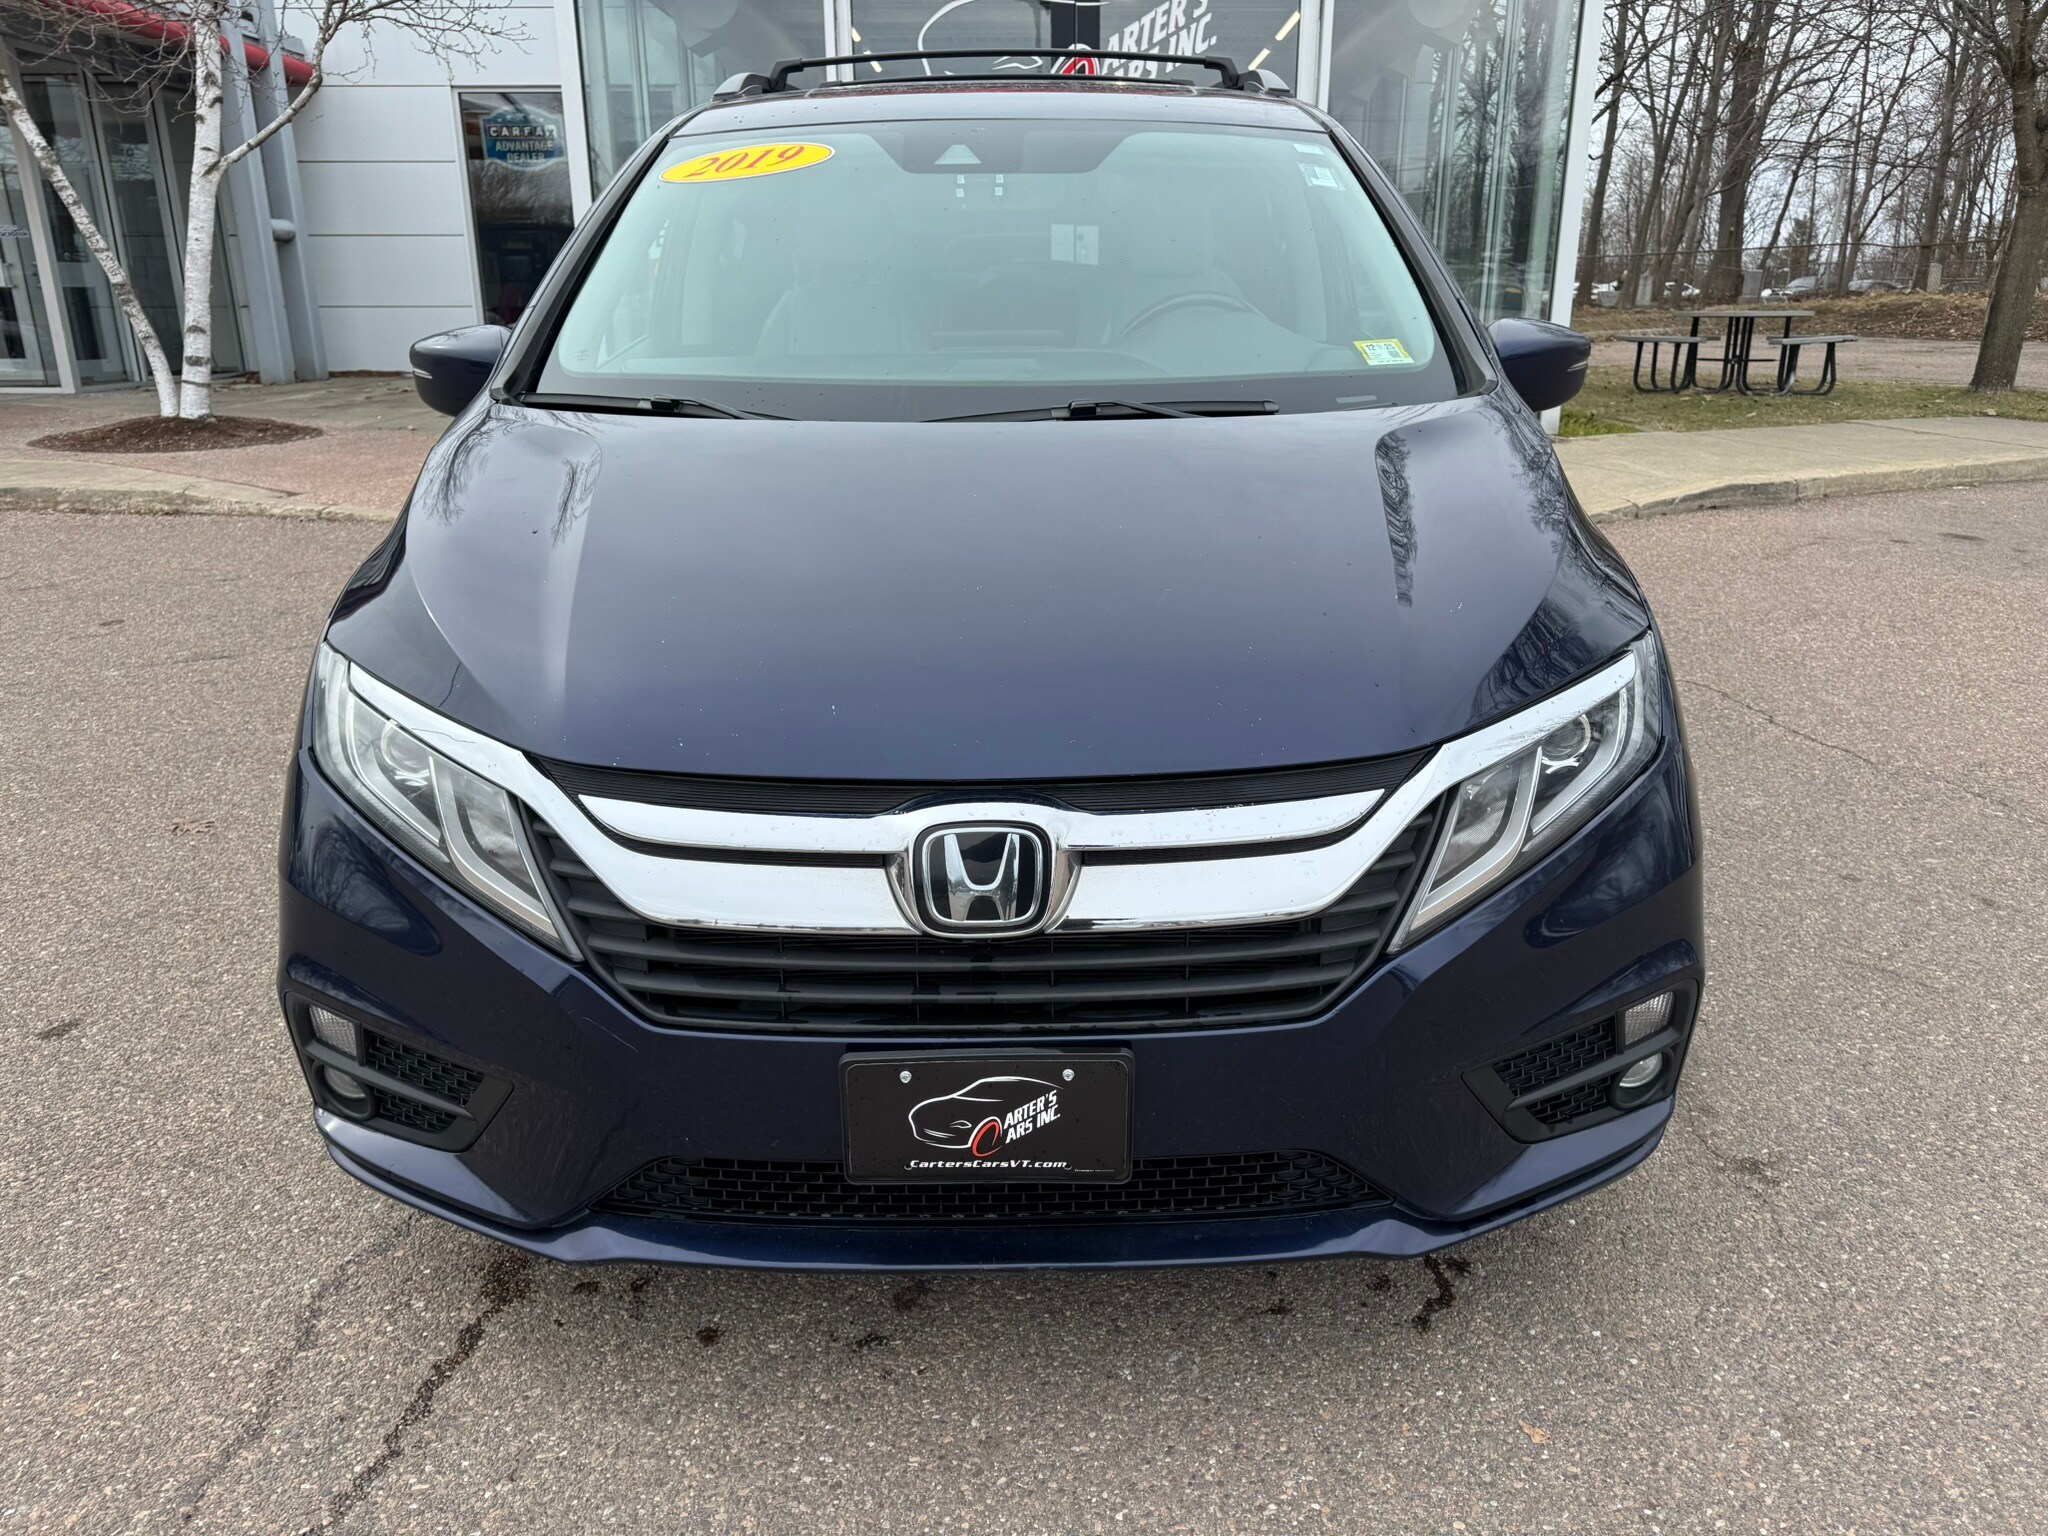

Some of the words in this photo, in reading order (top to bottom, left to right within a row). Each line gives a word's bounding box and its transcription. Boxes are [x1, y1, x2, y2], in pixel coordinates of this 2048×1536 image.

[1102, 0, 1209, 75] ARTER
[1166, 13, 1217, 73] INC.
[489, 125, 556, 138] CARFAX
[495, 141, 554, 152] ADVANTAGE
[506, 152, 546, 163] DEALER
[684, 145, 805, 178] 2019
[1036, 1104, 1061, 1128] INC.
[909, 1159, 1067, 1168] CartersCarsVT.com
